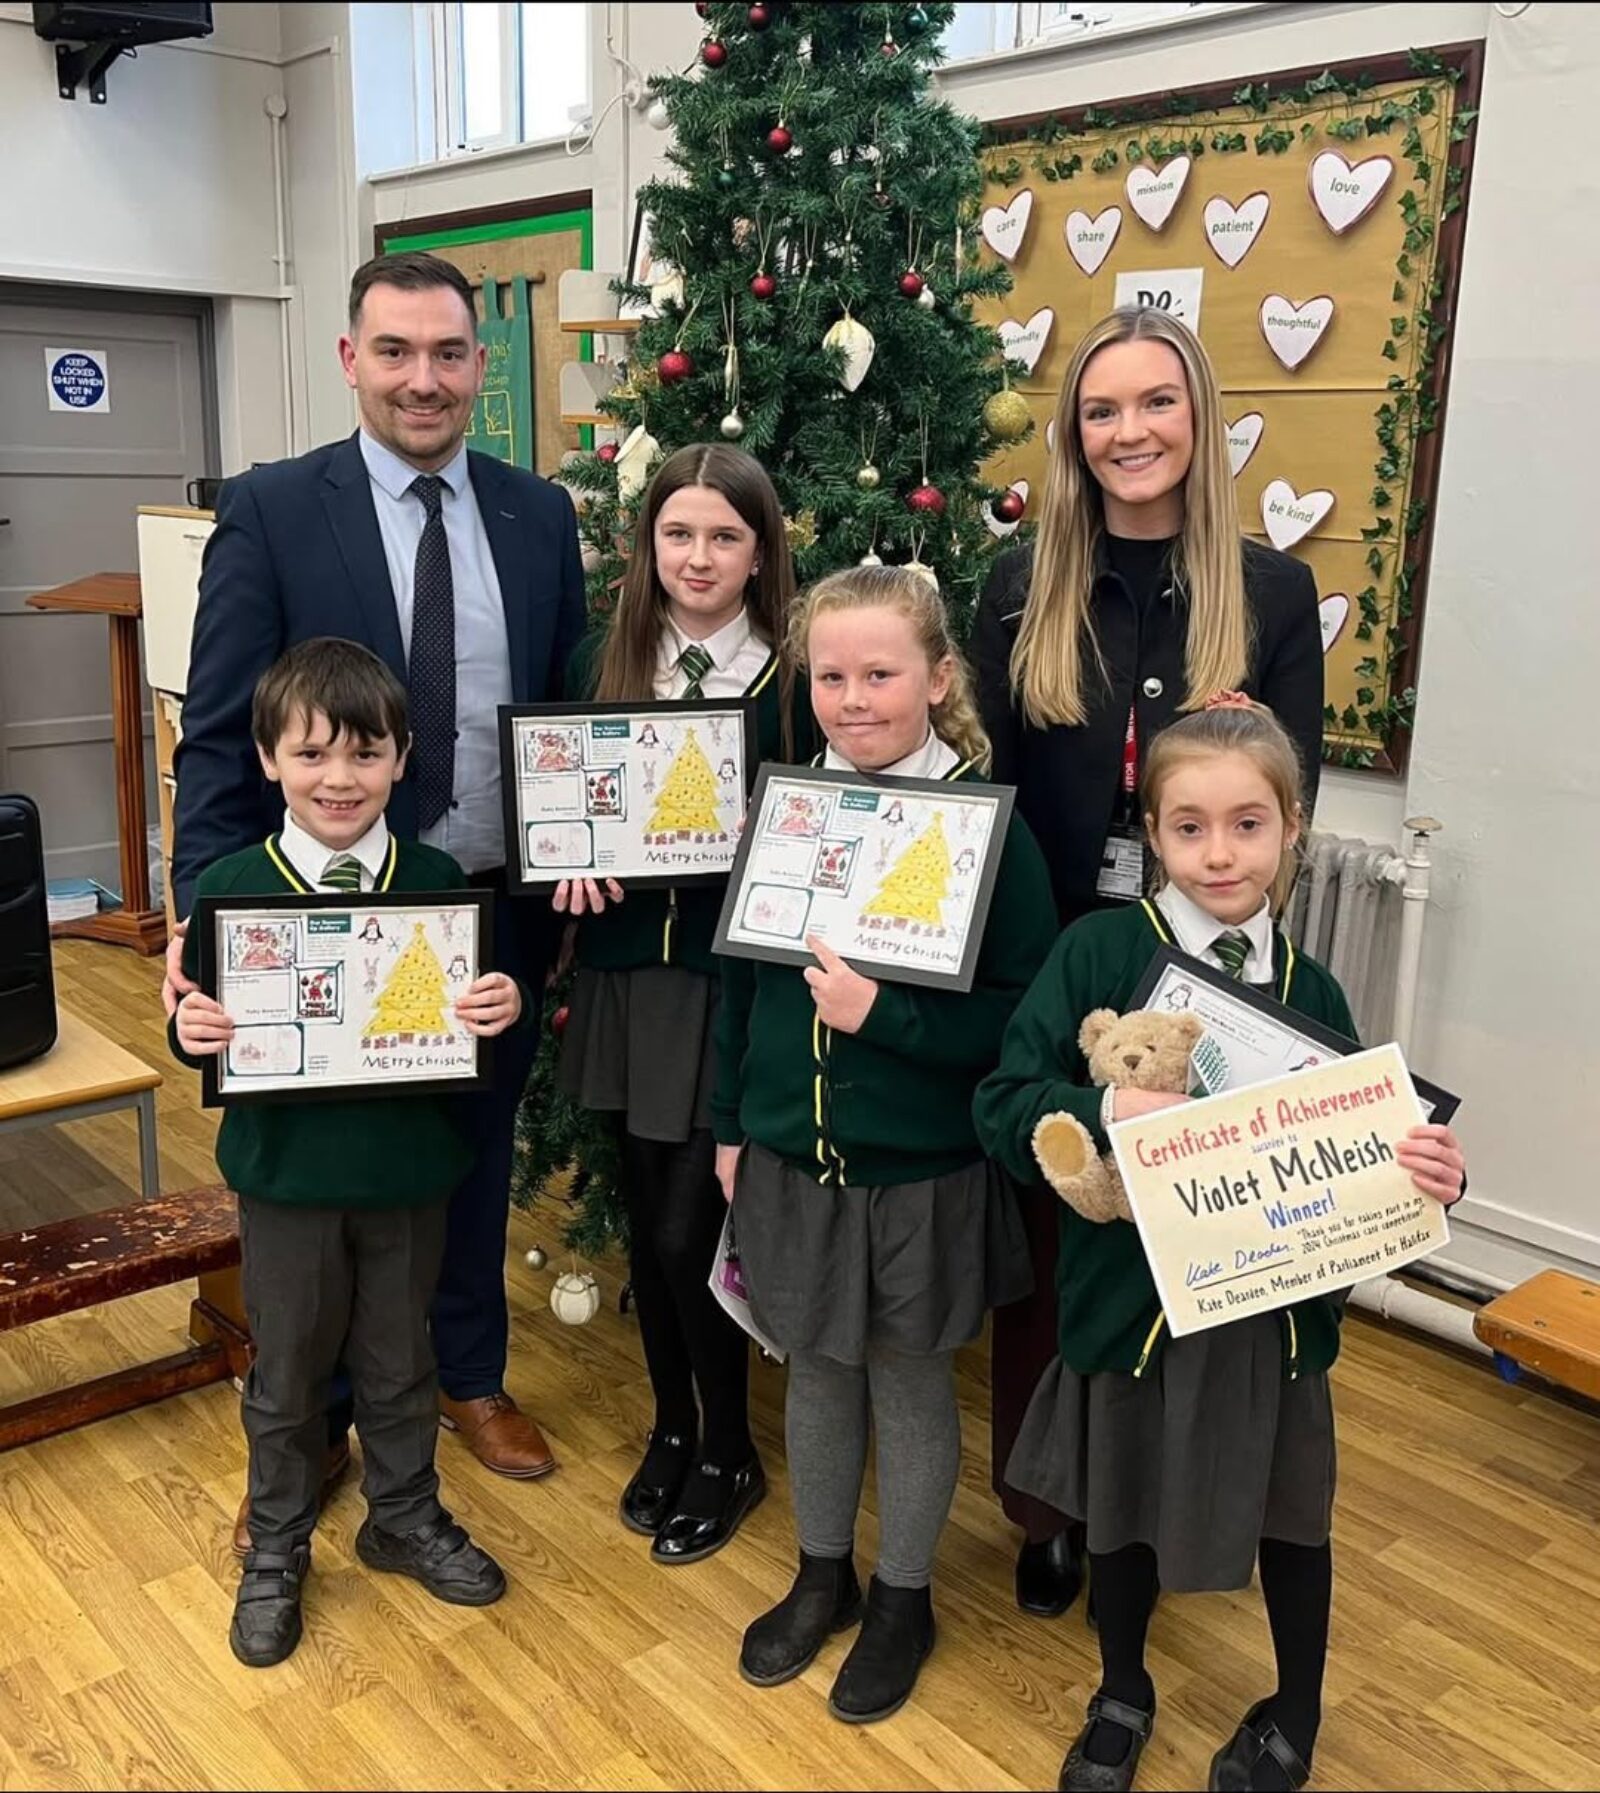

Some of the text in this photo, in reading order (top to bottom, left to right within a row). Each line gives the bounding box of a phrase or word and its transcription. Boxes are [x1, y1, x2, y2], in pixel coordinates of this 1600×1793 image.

[1136, 181, 1174, 196] mission
[1330, 178, 1360, 195] love
[996, 218, 1017, 233] care
[1212, 220, 1254, 235] patient
[1077, 231, 1105, 243] share
[1267, 316, 1321, 330] thoughtful
[1005, 331, 1041, 346] friendly
[65, 358, 88, 367] KEEP
[60, 367, 96, 377] LOCKED
[53, 375, 103, 386] SHUT WHEN
[64, 387, 93, 395] NOT IN
[69, 396, 87, 405] USE
[1269, 501, 1315, 524] be kind
[694, 851, 736, 862] Christ
[1136, 1075, 1395, 1168] Certificate of Achievement
[1173, 1131, 1393, 1217] Violet McNeish
[1263, 1188, 1336, 1229] Winner!
[1343, 1216, 1354, 1227] for
[1358, 1211, 1382, 1223] taking
[1385, 1204, 1400, 1215] part
[1402, 1200, 1411, 1209] in
[1302, 1240, 1321, 1254] 2024
[1323, 1226, 1360, 1247] Christmas
[1363, 1225, 1378, 1235] card
[1197, 1299, 1223, 1313] Kate
[1270, 1273, 1311, 1292] Member
[1317, 1263, 1326, 1279] of
[1329, 1250, 1381, 1274] Parliament
[1384, 1243, 1397, 1256] for
[1399, 1230, 1430, 1251] Halifax
